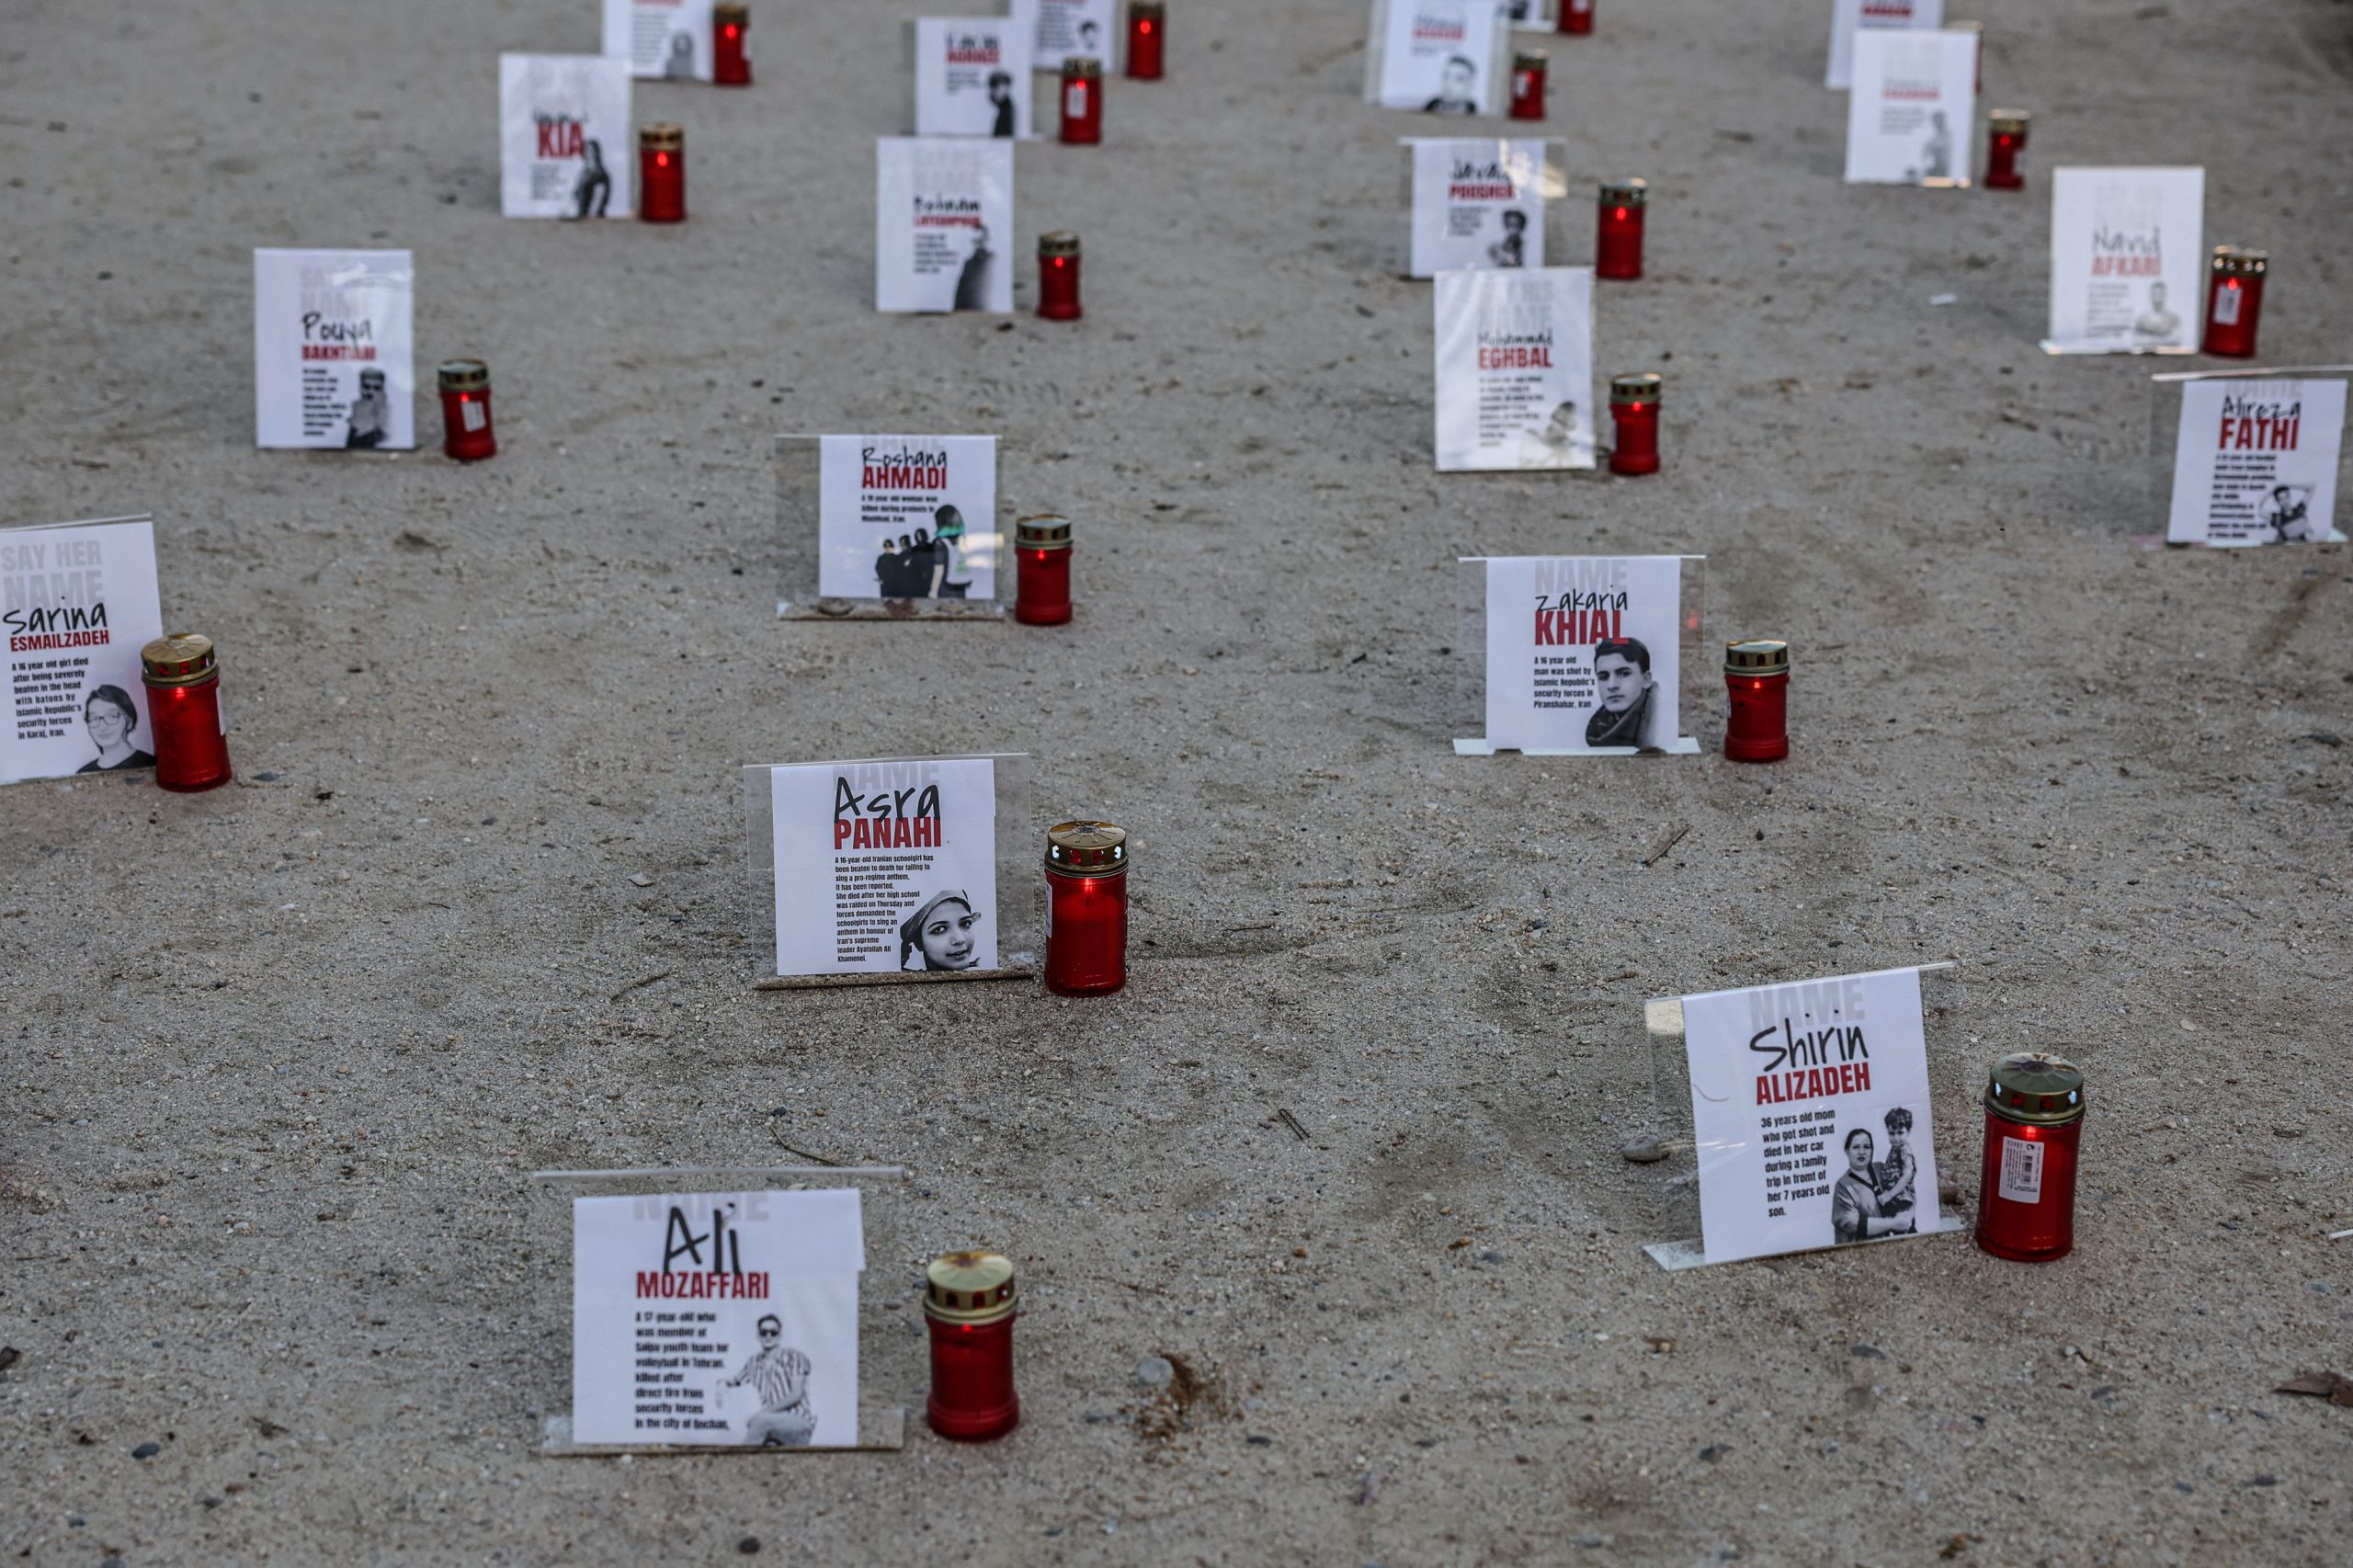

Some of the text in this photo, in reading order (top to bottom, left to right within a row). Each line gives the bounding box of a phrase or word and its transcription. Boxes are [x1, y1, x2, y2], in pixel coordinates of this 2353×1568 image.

[301, 310, 372, 355] Pouya
[1477, 347, 1554, 370] EGHBAL
[2219, 418, 2300, 451] FATHI
[862, 466, 948, 490] AHMADI
[0, 539, 103, 572] SAY HER
[1535, 559, 1628, 594] NAME
[3, 569, 105, 613] NAME
[1534, 609, 1629, 646] KHIAL
[9, 629, 109, 653] ESMAILZADEH
[28, 662, 43, 671] year
[45, 660, 57, 668] old
[73, 657, 88, 666] died
[13, 669, 85, 683] after being severely
[49, 683, 62, 691] the
[63, 681, 81, 689] head
[17, 708, 42, 717] Islamic
[17, 717, 73, 729] security forces
[832, 763, 939, 791] NAME
[834, 777, 941, 824] Asra
[834, 816, 942, 850] PANAHI
[872, 855, 892, 863] Iranian
[892, 855, 922, 863] schoolgirl
[835, 874, 848, 882] sing
[854, 874, 886, 882] pro-regime
[850, 865, 870, 873] beaten
[847, 892, 860, 900] died
[887, 891, 900, 899] high
[853, 882, 868, 891] been
[849, 901, 868, 909] raided
[877, 900, 903, 909] Thursday
[836, 918, 869, 927] schoolgirls
[876, 918, 890, 927] sing
[836, 928, 858, 937] anthem
[856, 945, 883, 954] Ayatollah
[1748, 976, 1866, 1034] NAME
[1749, 1009, 1870, 1073] Shirin
[1756, 1062, 1871, 1106] ALIZADEH
[1761, 1109, 1836, 1129] 36 years old mom
[1762, 1123, 1835, 1143] who got shot and
[1764, 1141, 1824, 1158] died in her car
[1765, 1154, 1827, 1173] during a family
[1766, 1176, 1781, 1188] trip
[1783, 1174, 1791, 1185] in
[1818, 1169, 1826, 1180] of
[1767, 1184, 1830, 1203] her 7 years old
[1768, 1206, 1787, 1218] son.
[664, 1202, 741, 1276] Ali
[636, 1271, 769, 1299] MOZAFFARI
